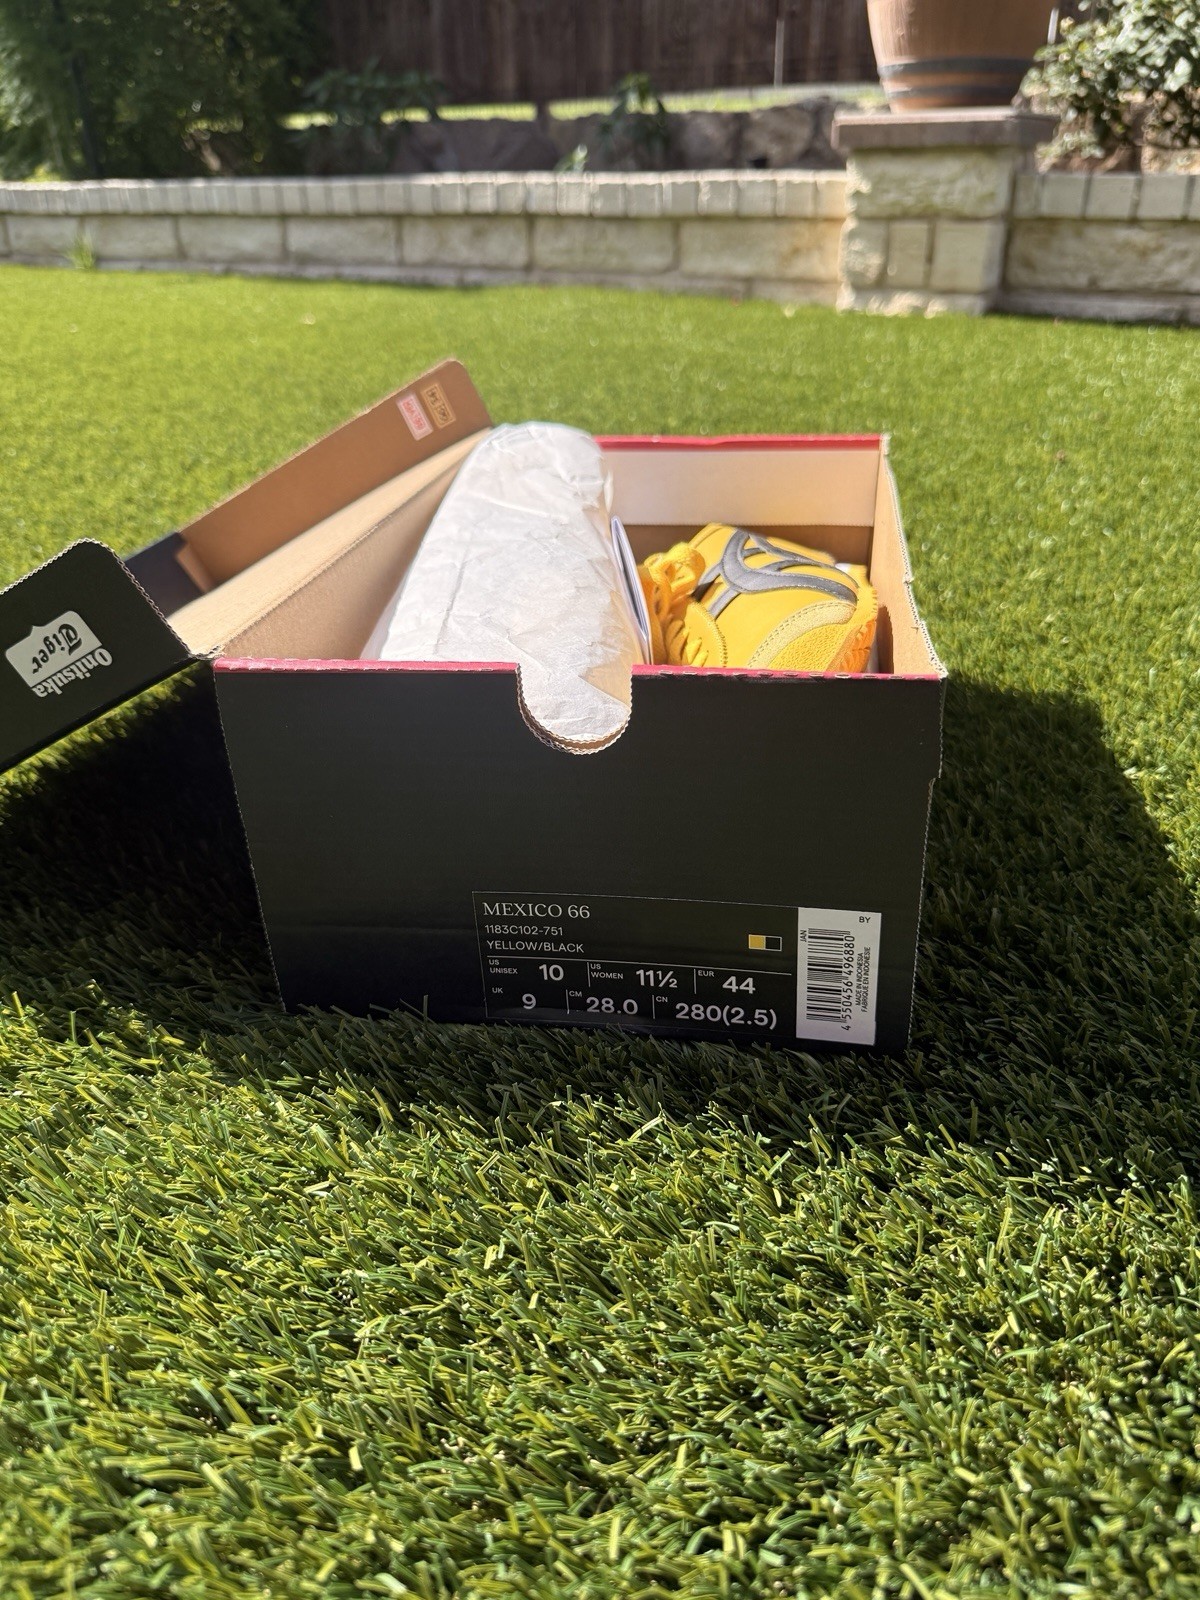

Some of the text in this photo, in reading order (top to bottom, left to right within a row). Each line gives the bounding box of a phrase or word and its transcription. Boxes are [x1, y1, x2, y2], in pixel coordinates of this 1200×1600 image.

[32, 623, 82, 674] Tiger
[31, 648, 113, 697] Onitsuka
[482, 902, 590, 919] MEXICO 66
[484, 924, 563, 936] 1183C102-751
[486, 940, 584, 953] YELLOW/BLACK
[489, 967, 518, 975] UNISEX
[538, 963, 565, 981] 10
[591, 971, 624, 980] WOMEN
[722, 975, 756, 994] 44
[521, 993, 537, 1010] 9
[568, 990, 582, 998] CM
[586, 996, 638, 1015] 28.0
[675, 1002, 777, 1030] 280(2.5)
